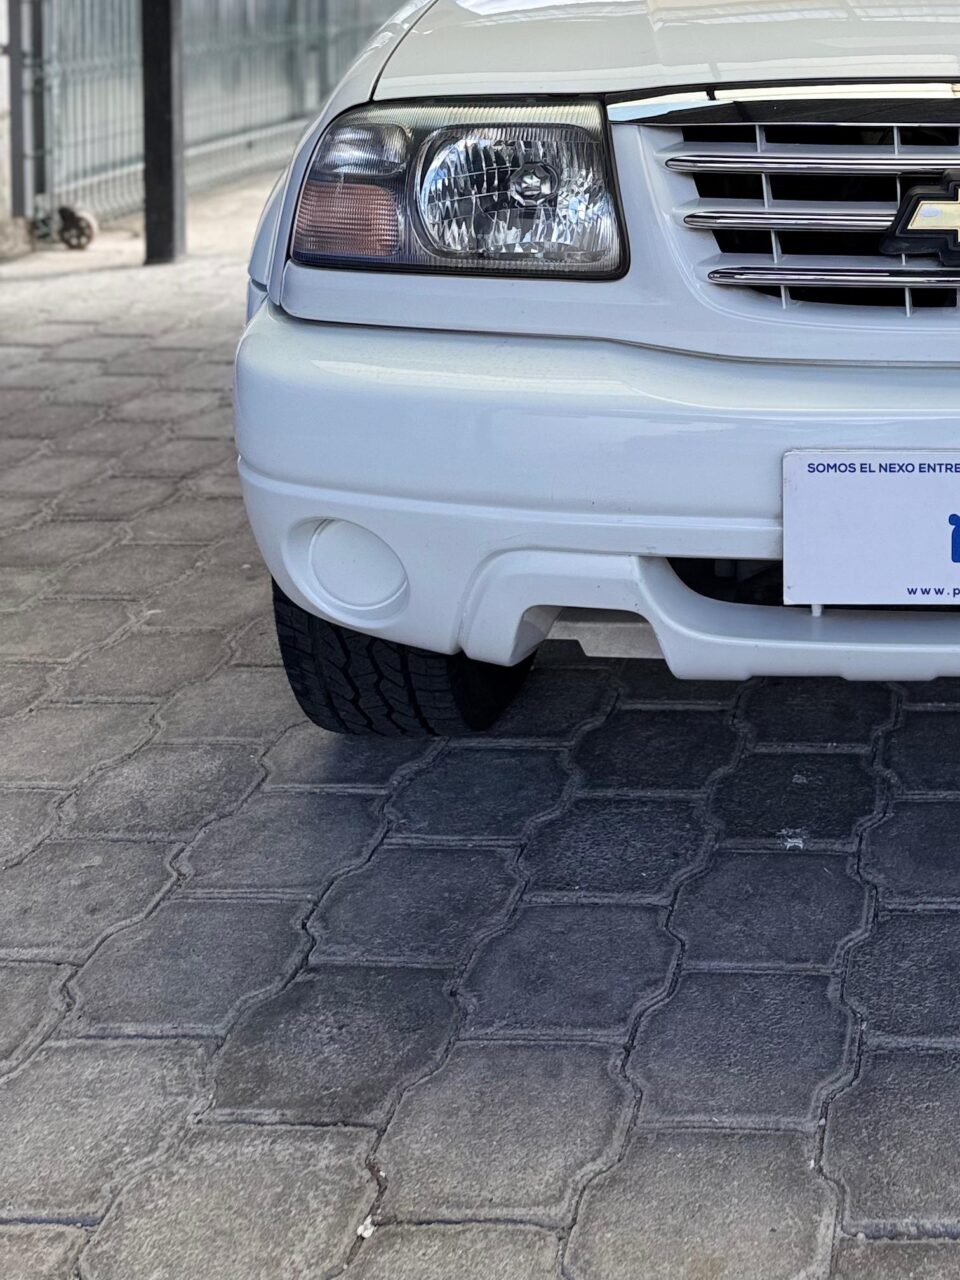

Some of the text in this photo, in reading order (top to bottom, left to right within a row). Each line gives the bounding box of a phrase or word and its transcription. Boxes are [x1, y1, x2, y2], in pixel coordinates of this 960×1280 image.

[807, 462, 857, 474] SOMOS
[859, 463, 876, 473] EL
[878, 463, 916, 473] NEXO
